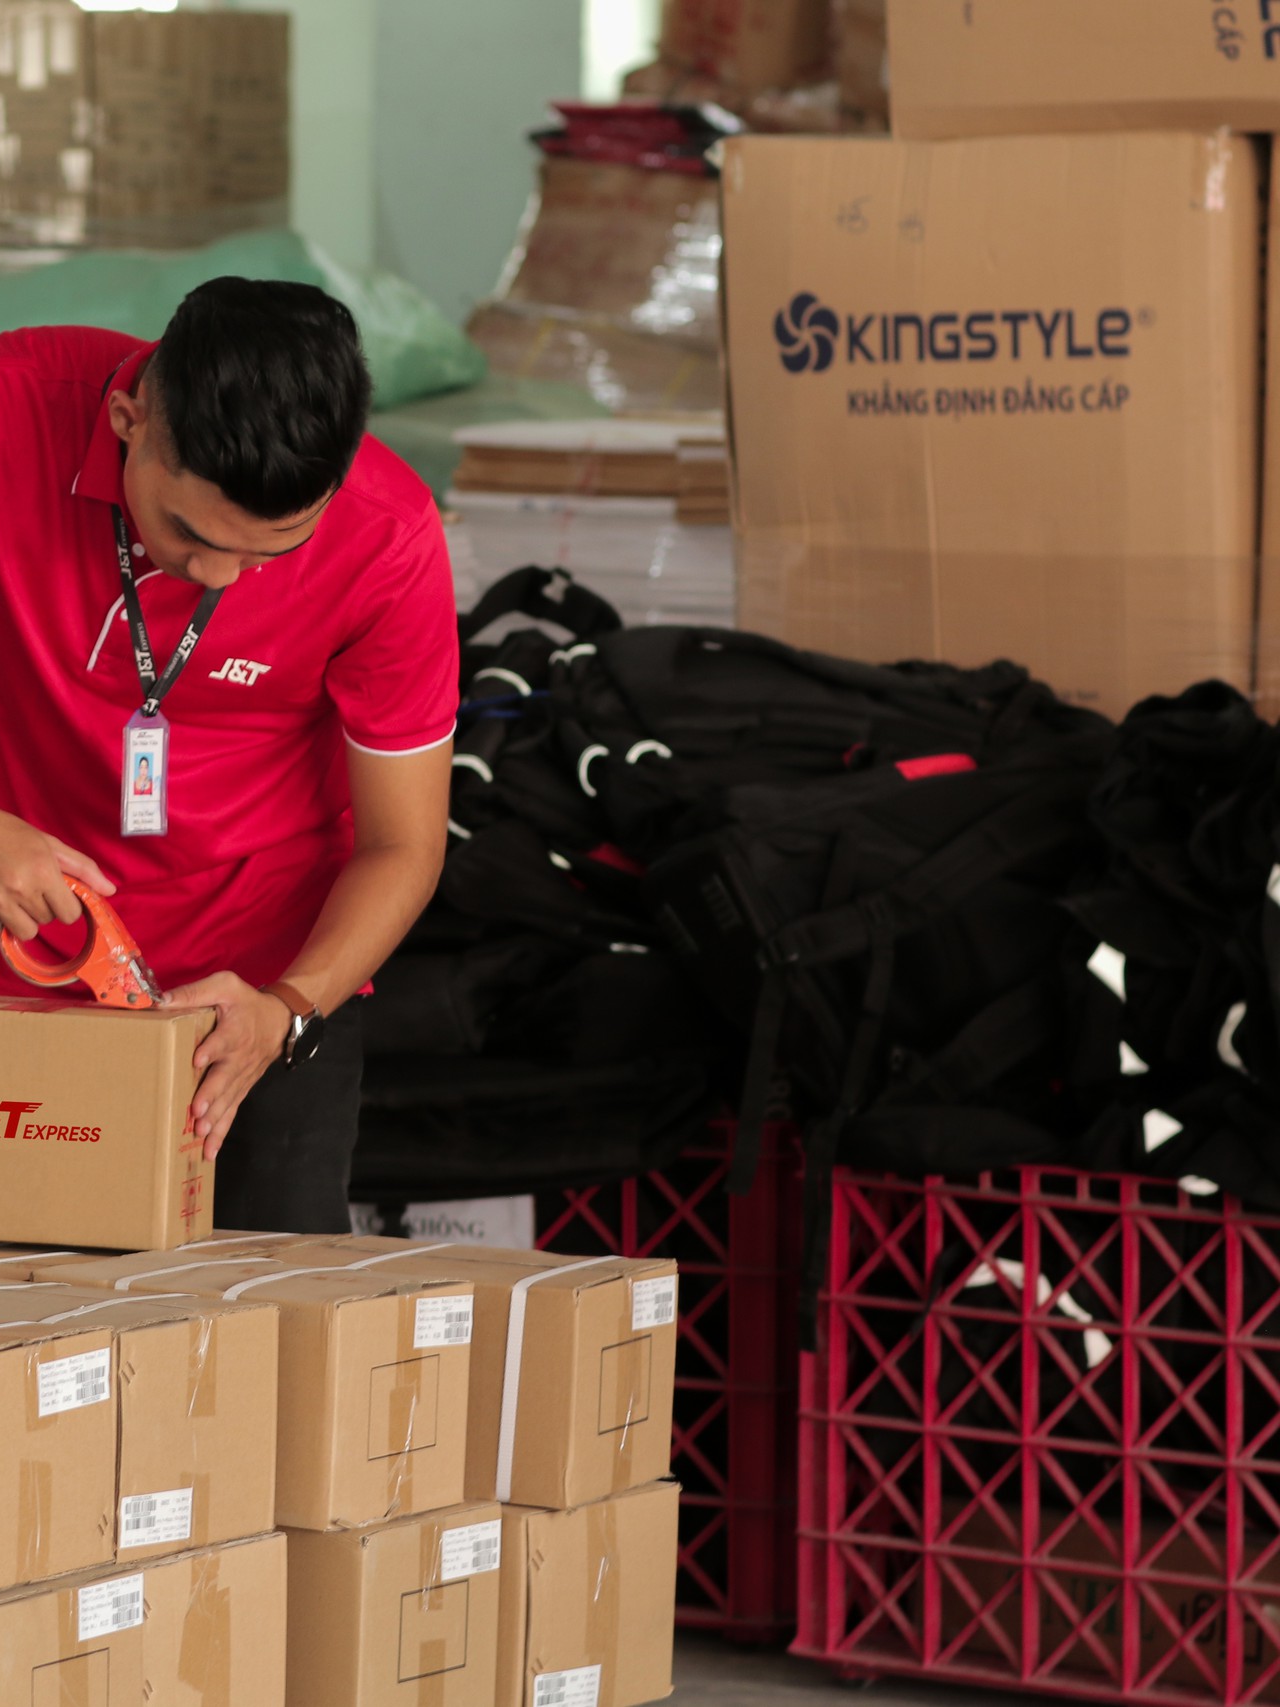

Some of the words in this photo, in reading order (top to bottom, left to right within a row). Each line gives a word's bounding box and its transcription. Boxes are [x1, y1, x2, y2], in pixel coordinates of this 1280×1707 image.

[177, 623, 199, 664] J&T
[135, 647, 156, 682] J&T
[208, 658, 272, 686] J&T
[22, 1124, 102, 1143] EXPRESS
